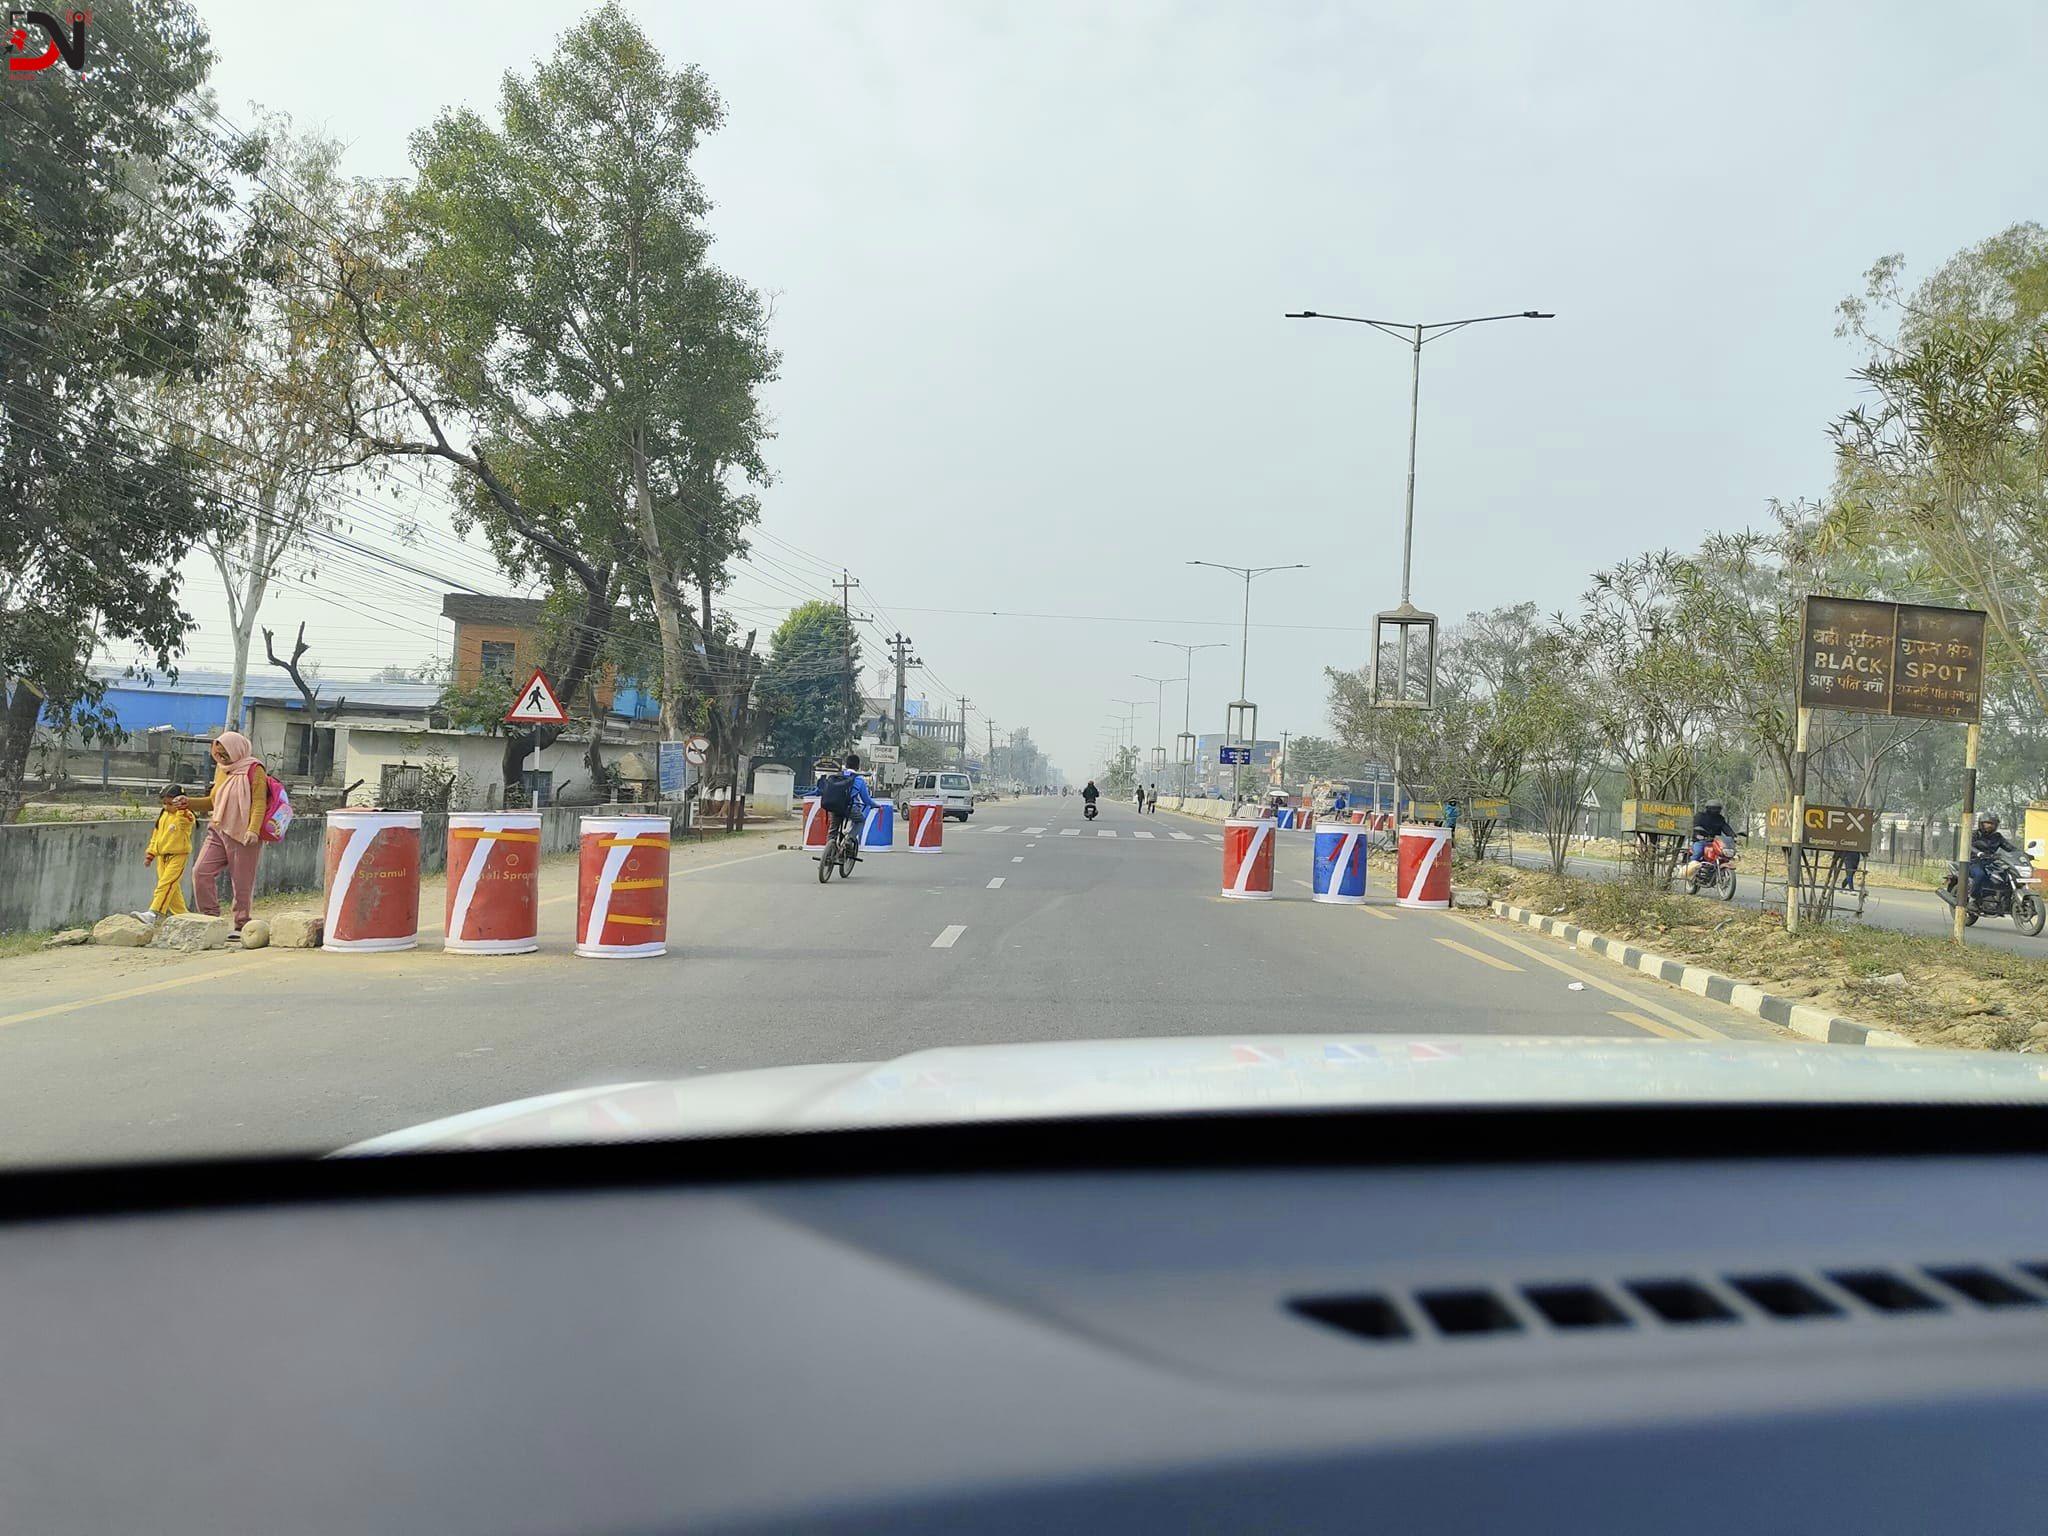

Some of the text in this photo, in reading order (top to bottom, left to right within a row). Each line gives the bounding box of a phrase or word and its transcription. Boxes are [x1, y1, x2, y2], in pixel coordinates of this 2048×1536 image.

[1905, 662, 1967, 683] SPOT
[1657, 818, 1676, 830] GAS
[1770, 807, 1792, 828] QFX
[1805, 808, 1865, 833] QFX
[359, 867, 406, 880] Spramul
